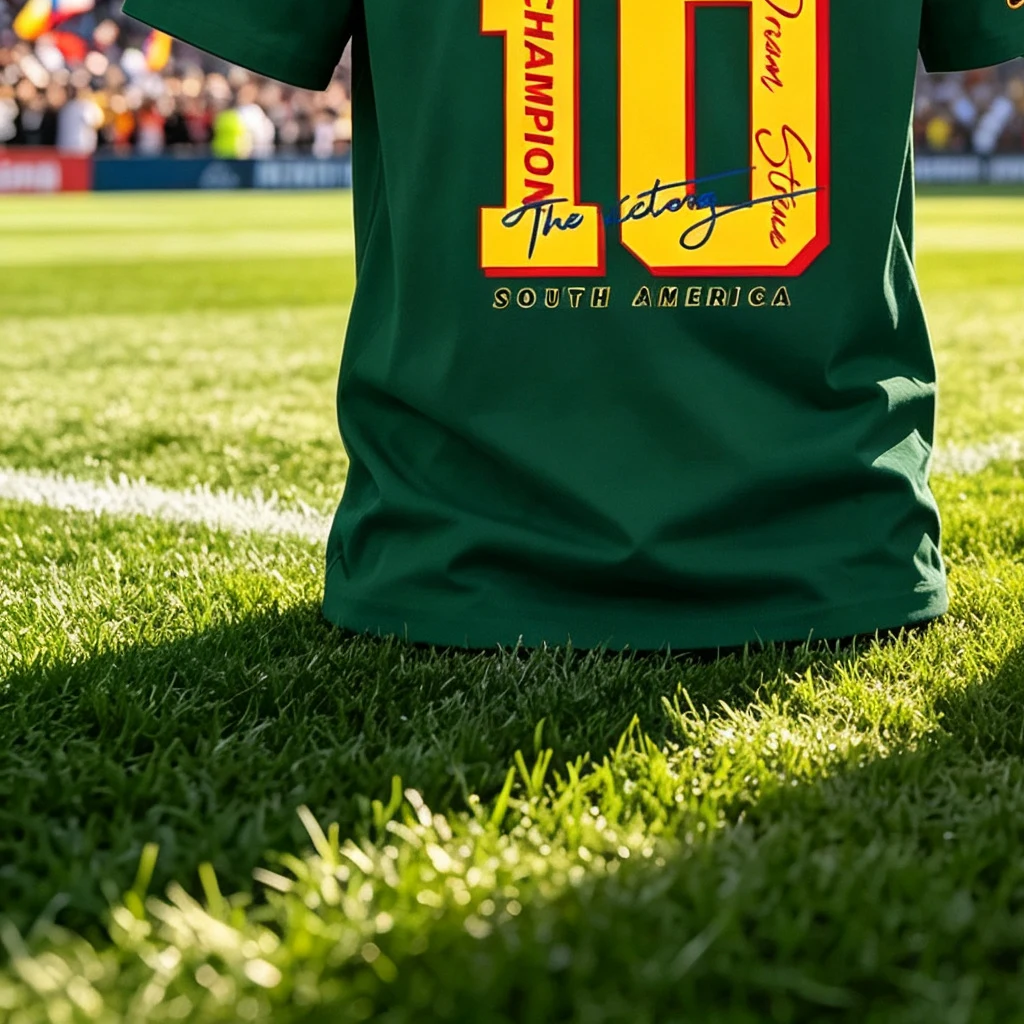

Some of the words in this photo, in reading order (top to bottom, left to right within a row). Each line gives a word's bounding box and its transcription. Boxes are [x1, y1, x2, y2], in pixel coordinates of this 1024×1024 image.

[501, 198, 584, 260] The
[492, 286, 611, 309] SOUTH
[631, 286, 792, 308] AMERICA
